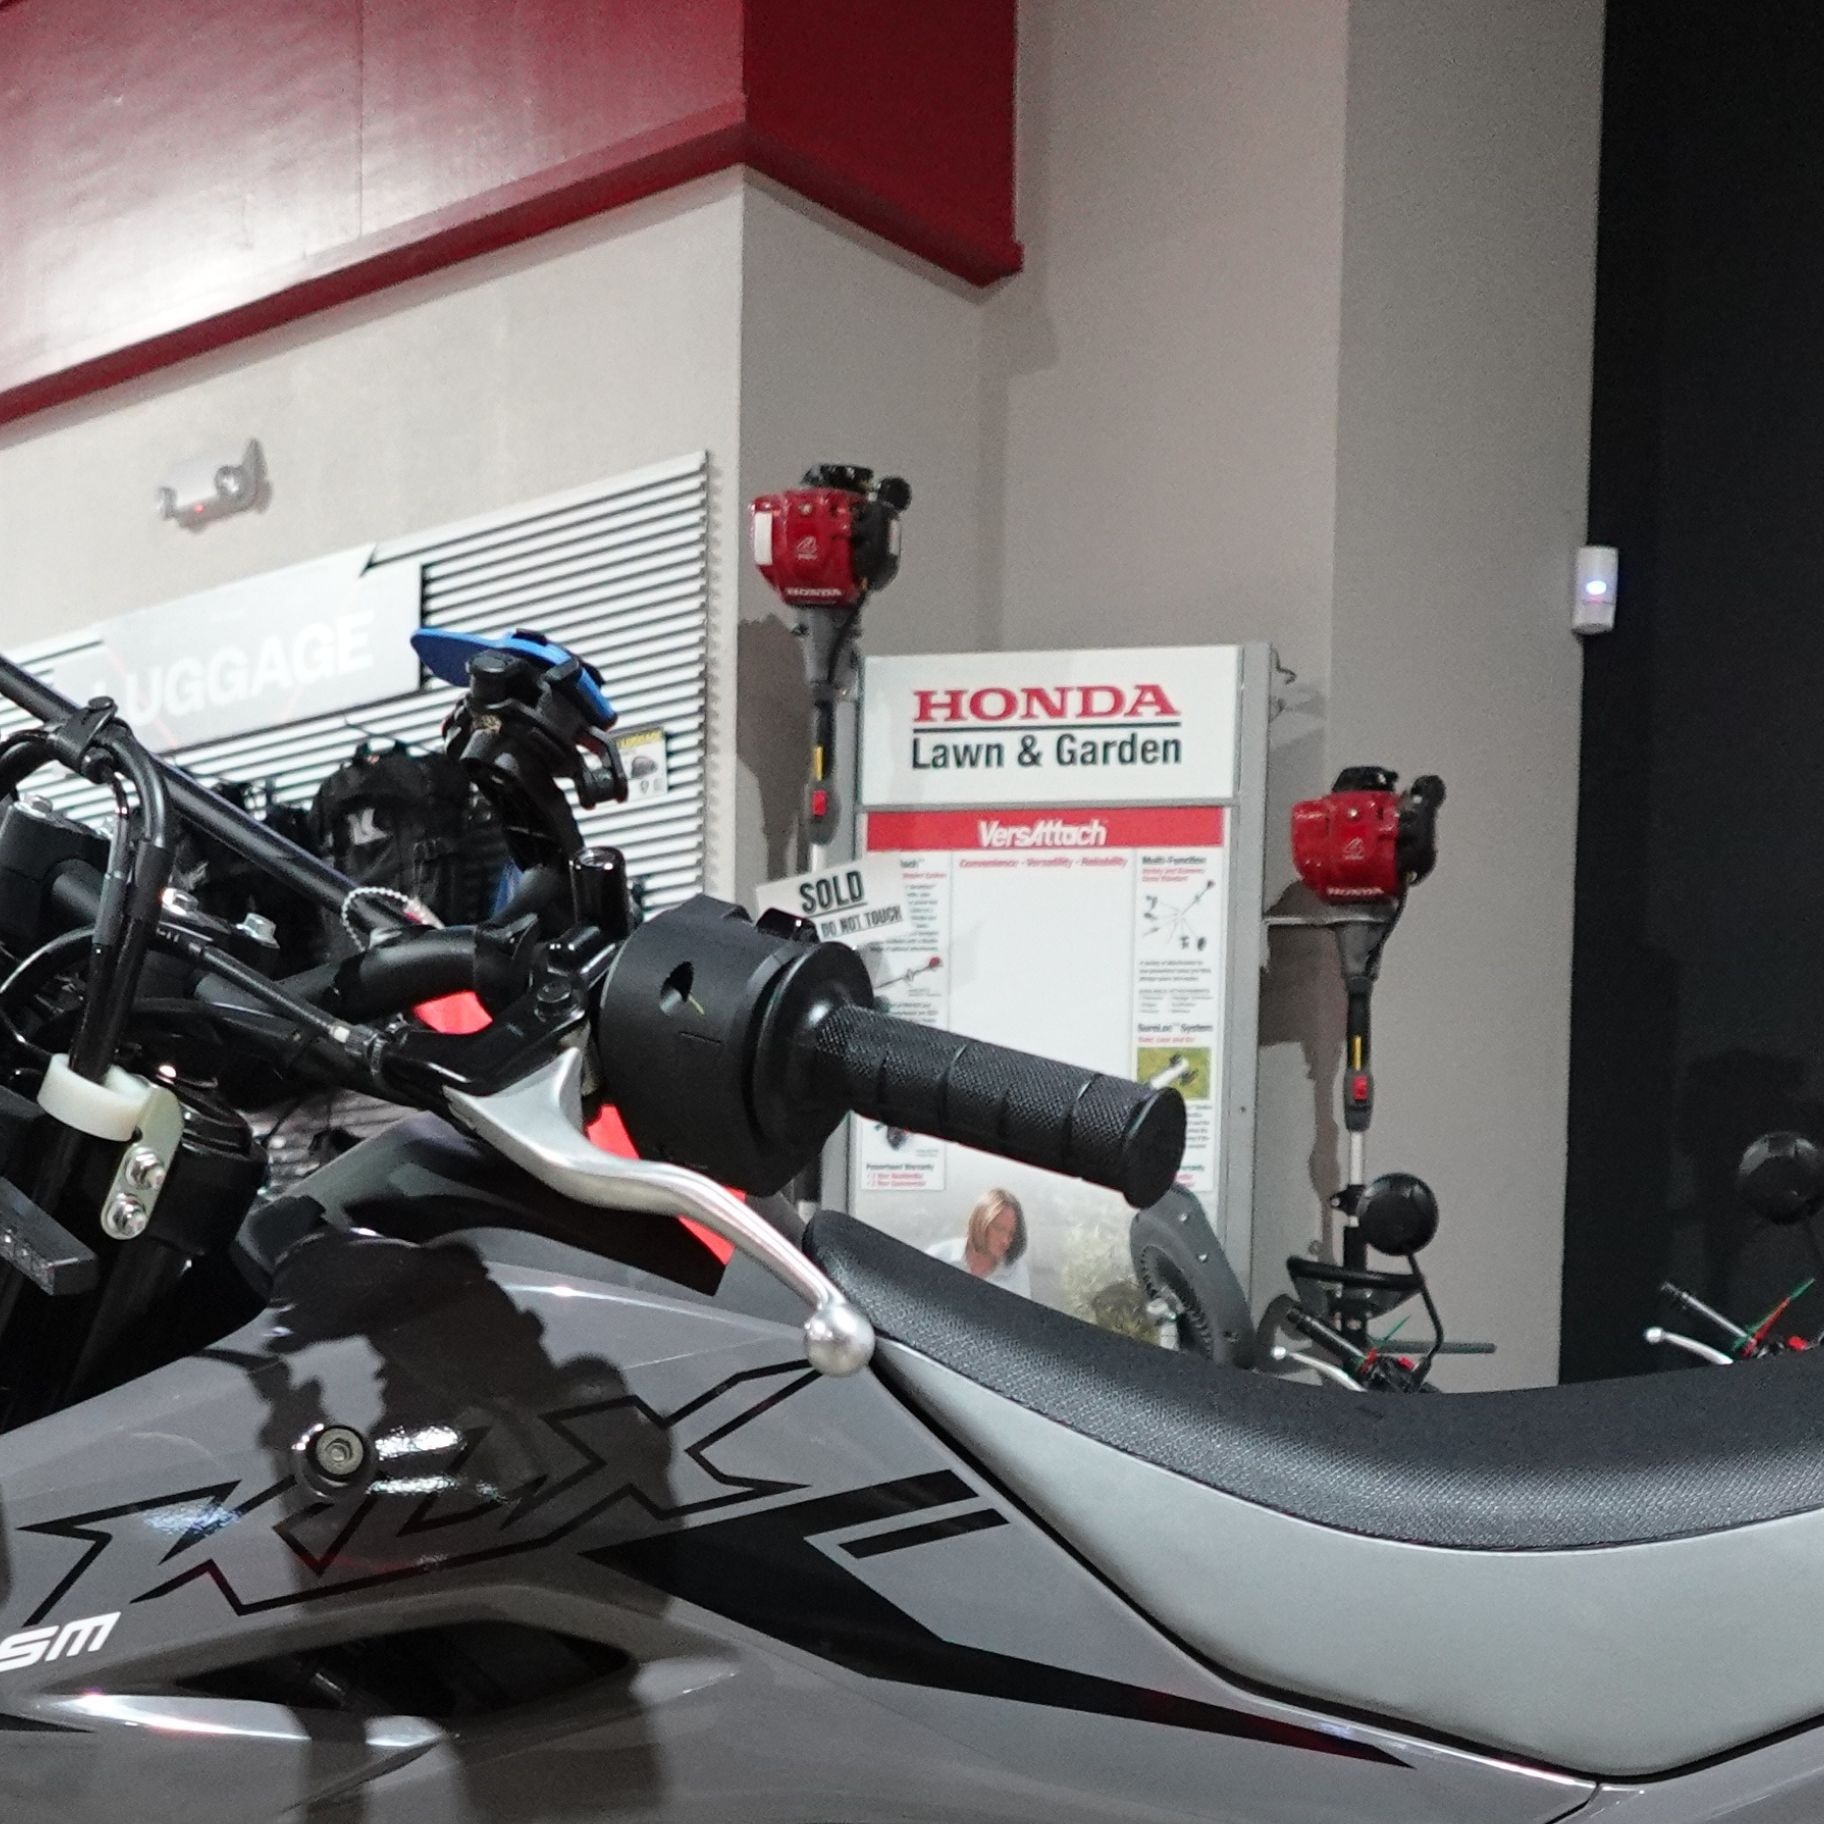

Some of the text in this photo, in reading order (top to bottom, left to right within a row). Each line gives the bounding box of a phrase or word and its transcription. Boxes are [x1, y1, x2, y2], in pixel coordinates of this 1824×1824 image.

[94, 610, 375, 727] UGGAGE
[913, 685, 1181, 722] HONDA
[912, 732, 1182, 769] Lawn & Garden
[978, 819, 1108, 848] VersAttach
[799, 870, 866, 915] SOLD
[821, 904, 904, 938] DO NOT TOUCH
